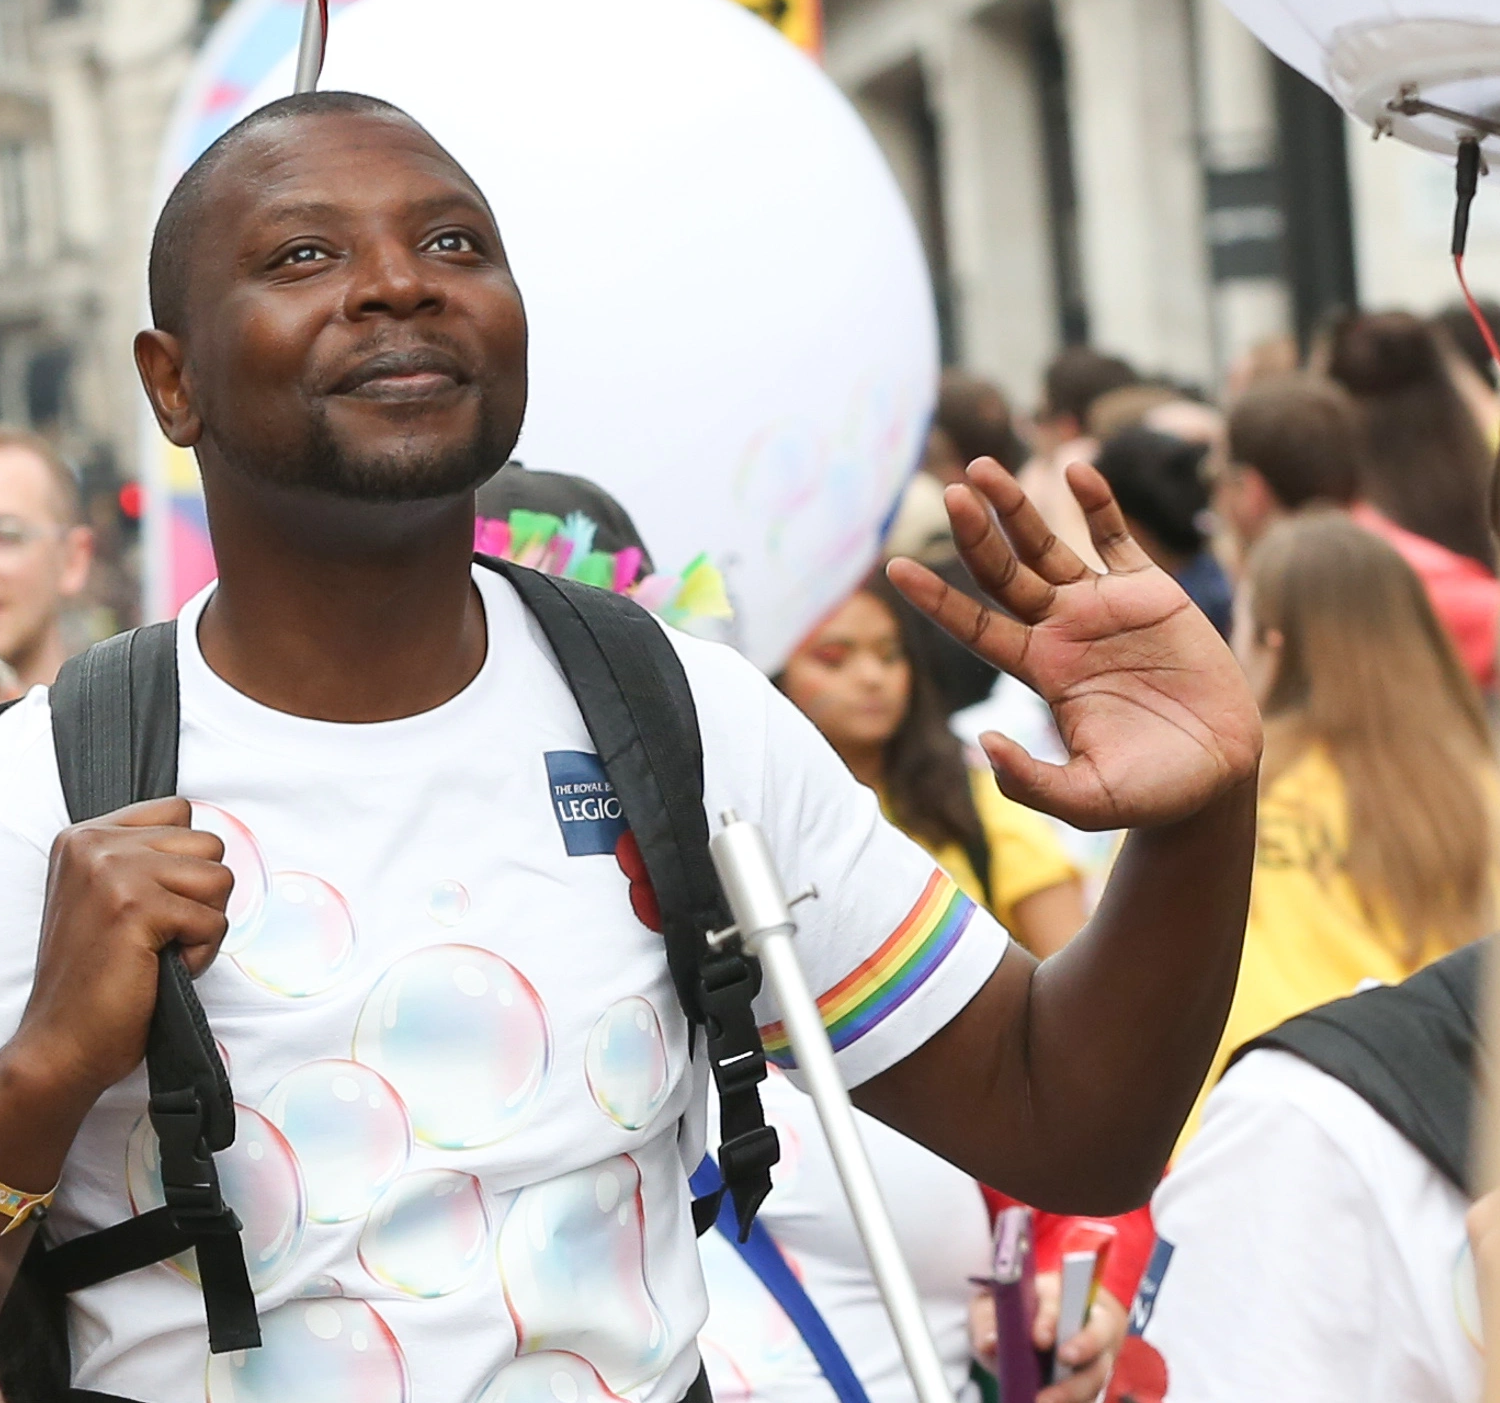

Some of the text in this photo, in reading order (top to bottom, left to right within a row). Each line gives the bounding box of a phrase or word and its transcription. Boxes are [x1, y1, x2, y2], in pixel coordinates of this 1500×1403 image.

[554, 784, 573, 796] THE
[573, 782, 603, 794] ROYAL
[557, 797, 623, 822] LEGIO
